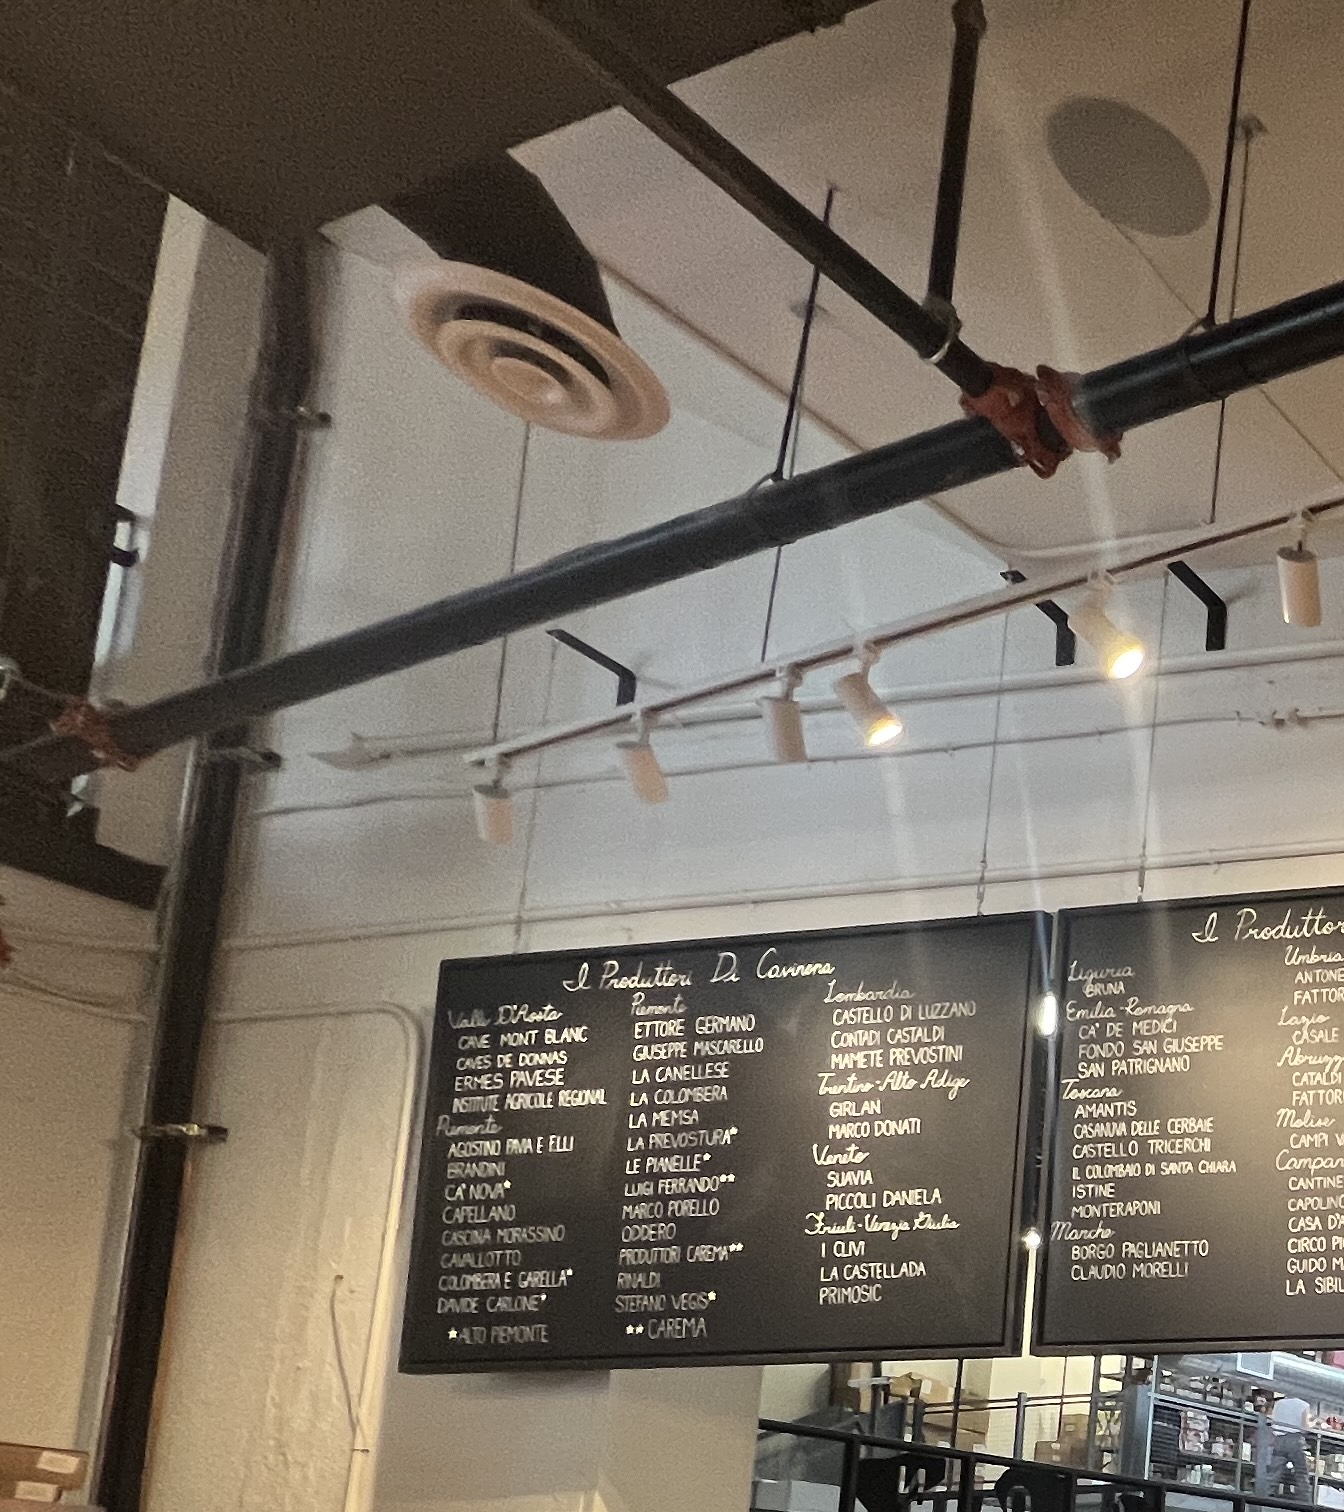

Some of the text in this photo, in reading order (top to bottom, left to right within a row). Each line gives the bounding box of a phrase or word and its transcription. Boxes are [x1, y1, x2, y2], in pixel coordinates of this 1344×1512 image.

[1285, 945, 1344, 965] Umbria
[599, 960, 692, 990] Produttori
[710, 952, 740, 983] Di
[833, 1001, 976, 1026] CASTELLO DI LUZZANO
[500, 1030, 538, 1047] MONT
[544, 1026, 588, 1045] BLANC
[634, 1014, 755, 1039] ETTORE GERMANO
[831, 1045, 963, 1069] MAMETE PREVOSTINI
[1079, 1035, 1224, 1059] FONDO SAN GIUSEPPE
[497, 1053, 513, 1068] DE
[1078, 1055, 1190, 1078] SAN PATRIGNANO
[631, 1062, 729, 1084] LA CANELLESE
[830, 1100, 881, 1117] GIRLAN
[1074, 1100, 1137, 1118] AMANTIS
[829, 1118, 920, 1139] MARCO DONATI
[1290, 1133, 1328, 1148] CAMPI
[812, 1143, 869, 1165] Veneto
[827, 1170, 873, 1187] SUAVIA
[826, 1188, 942, 1210] PICCOLI DANIELA
[1073, 1183, 1115, 1199] ISTINE
[1071, 1201, 1161, 1218] MONTERAPONI
[1072, 1239, 1208, 1260] BORGO PAGLIANETTO
[821, 1261, 926, 1281] LA CASTELLADA
[820, 1284, 882, 1305] PRIMOSIC
[1286, 1279, 1305, 1295] LA
